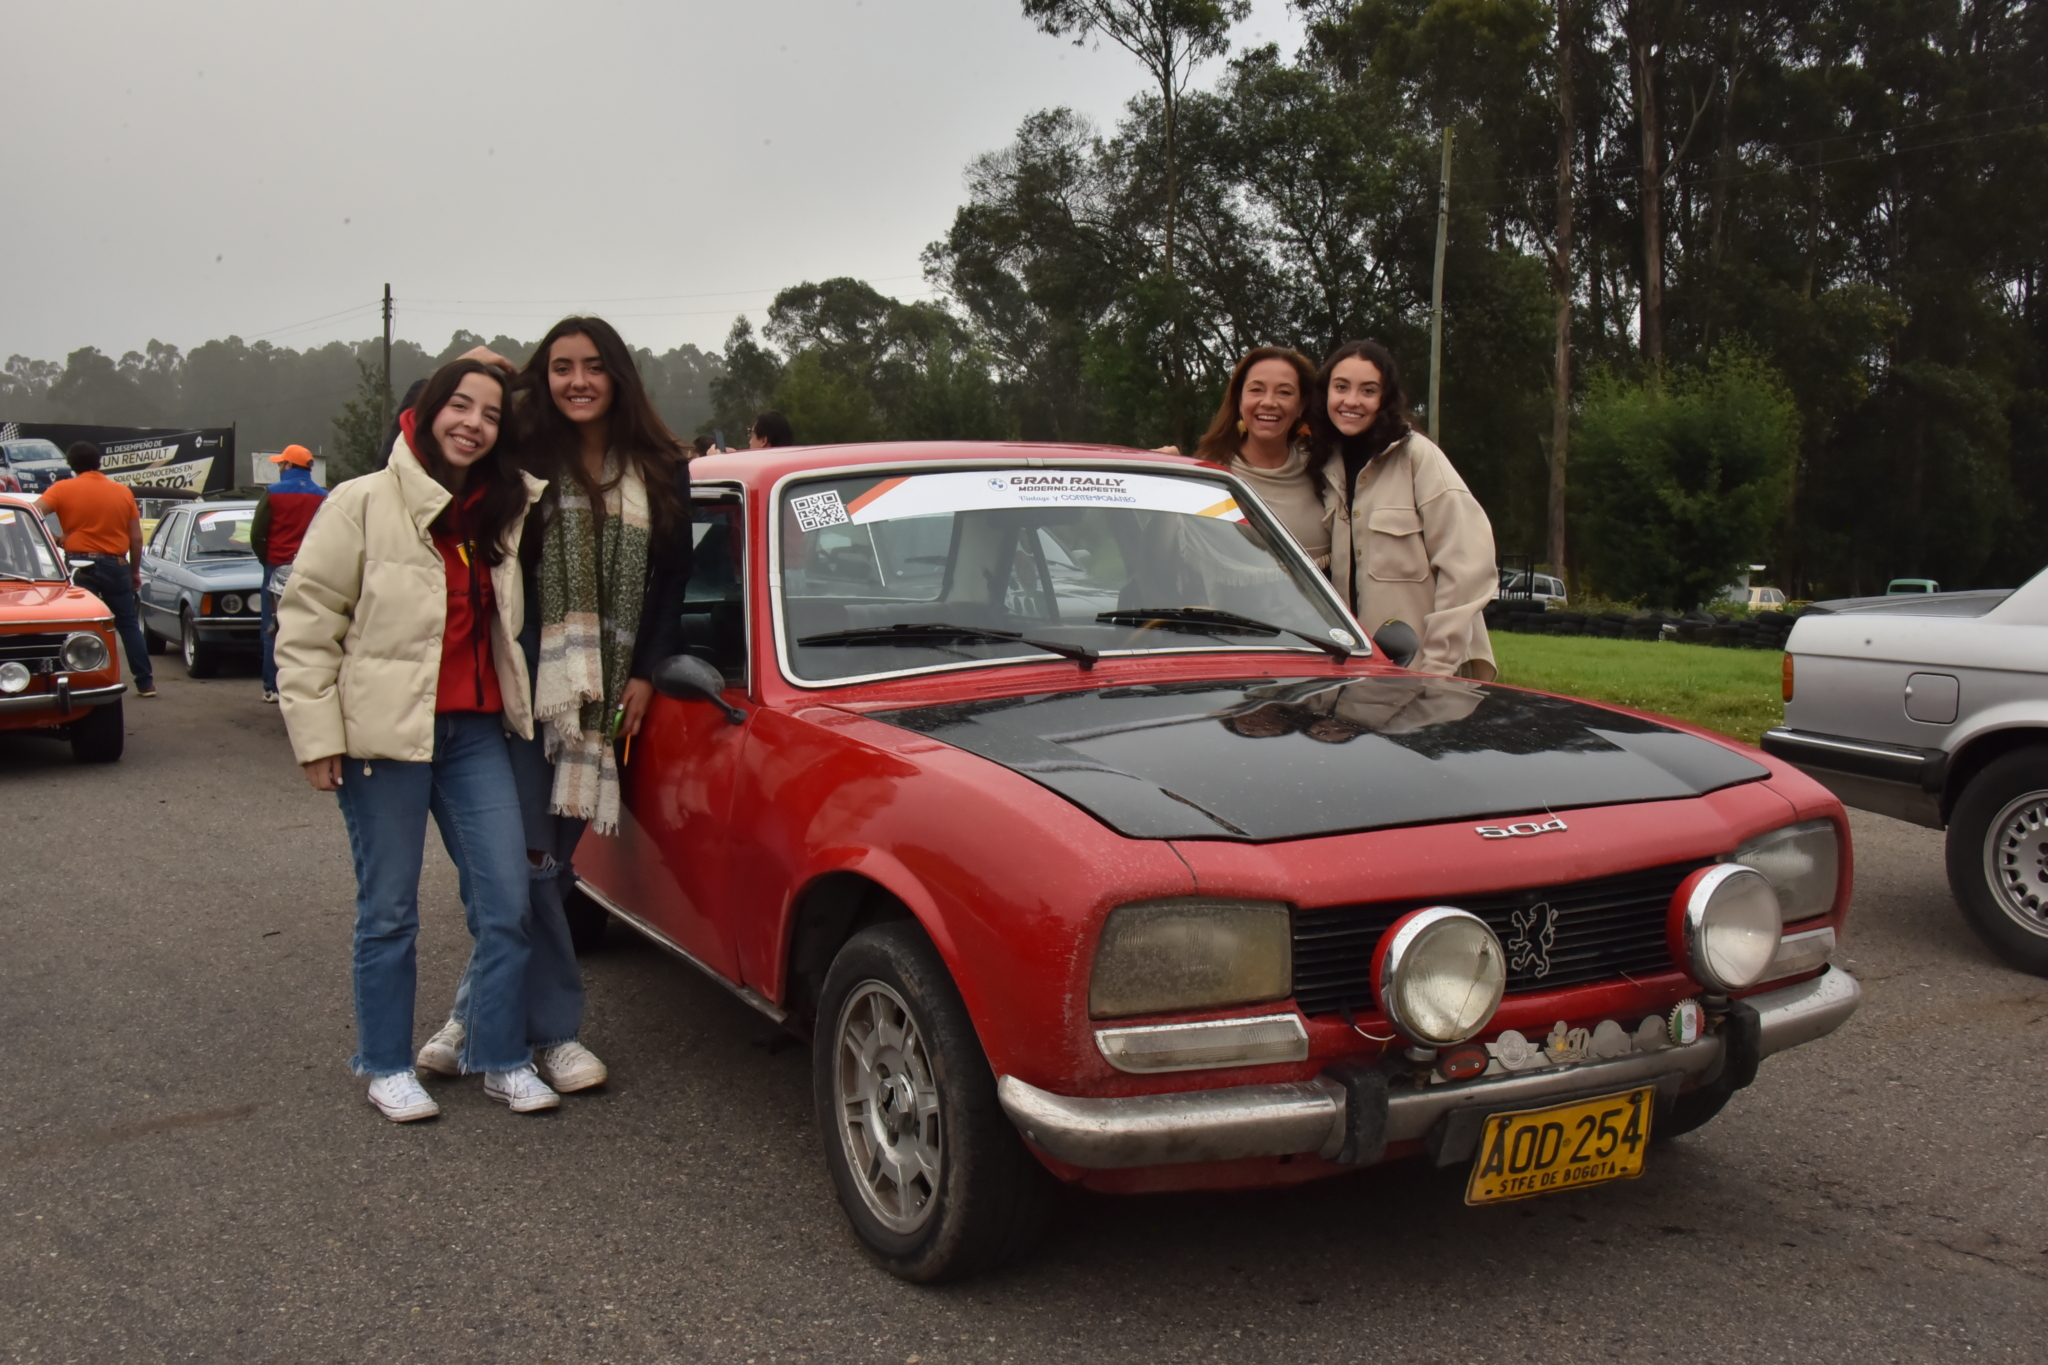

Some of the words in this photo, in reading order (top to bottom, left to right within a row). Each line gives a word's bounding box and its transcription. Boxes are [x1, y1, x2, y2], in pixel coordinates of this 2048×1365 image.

[105, 446, 114, 454] EL
[114, 440, 153, 453] DESEMPEÑO
[102, 455, 120, 467] UN
[122, 448, 169, 465] RENAULT
[132, 472, 141, 480] LO
[142, 464, 183, 479] CONOCEMOS
[183, 464, 193, 472] EN
[1010, 476, 1064, 485] GRAN
[1069, 477, 1125, 487] RALLY
[1474, 819, 1568, 840] 504
[1480, 1119, 1565, 1179] AOD
[1568, 1099, 1643, 1164] 254
[1498, 1175, 1537, 1194] STFE
[1540, 1171, 1559, 1187] DE
[1563, 1161, 1616, 1183] BOGOTA
